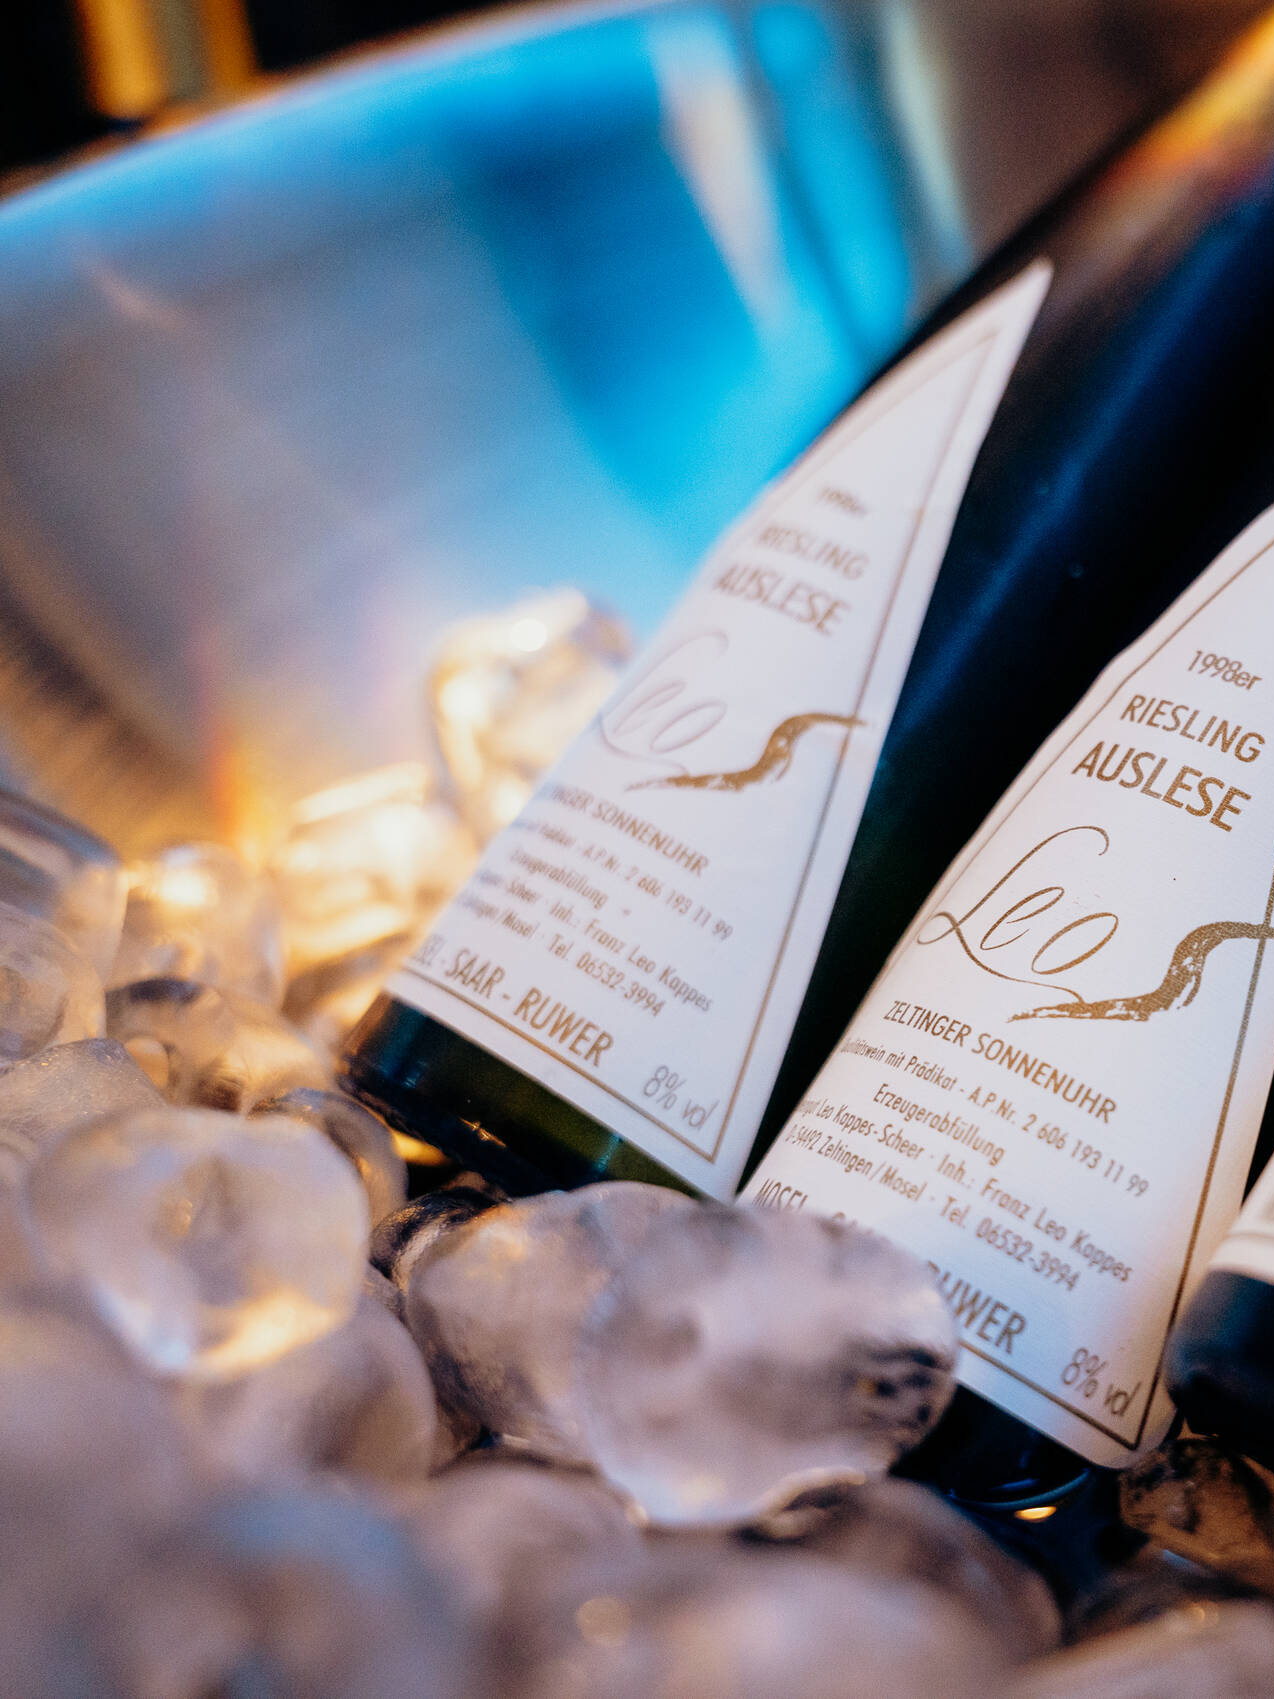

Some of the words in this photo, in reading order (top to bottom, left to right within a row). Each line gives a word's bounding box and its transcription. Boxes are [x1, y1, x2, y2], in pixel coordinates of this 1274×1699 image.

[759, 525, 869, 580] RIESLING
[713, 563, 850, 637] AUSLESE
[600, 629, 730, 774] Leo
[1186, 650, 1264, 692] 1998er
[1120, 694, 1266, 763] RIESLING
[1071, 741, 1252, 832] AUSLESE
[592, 801, 709, 877] SONNENUHR
[666, 889, 693, 915] 193
[693, 906, 712, 928] 11
[712, 920, 734, 941] 99
[916, 826, 1120, 1001] Leo
[444, 947, 506, 999] SAAR
[512, 986, 614, 1068] RUWER
[576, 951, 667, 1018] 06532-3994
[584, 918, 627, 955] Franz
[627, 945, 656, 974] Leo
[658, 965, 713, 1013] Kappes
[642, 1064, 689, 1110] 8%
[681, 1098, 721, 1131] vol
[883, 1000, 973, 1048] ZELTINGER
[971, 1032, 1117, 1125] SONNENUHR
[872, 1082, 1005, 1168] Erzeugerabfüllung
[884, 1051, 906, 1069] mit
[903, 1055, 958, 1092] Prädikat
[1021, 1113, 1038, 1133] 2
[1037, 1122, 1069, 1151] 606
[1071, 1139, 1103, 1170] 193
[1103, 1159, 1124, 1184] 11
[1126, 1173, 1150, 1198] 99
[816, 1098, 834, 1120] Leo
[980, 1176, 1032, 1221] Franz
[1033, 1207, 1067, 1242] Leo
[1069, 1229, 1134, 1283] Kappes
[939, 1196, 972, 1230] Tel.
[975, 1216, 1082, 1292] 06532-3994
[927, 1260, 1027, 1355] UWER
[1060, 1347, 1108, 1398] 8%
[1103, 1380, 1143, 1417] vol
